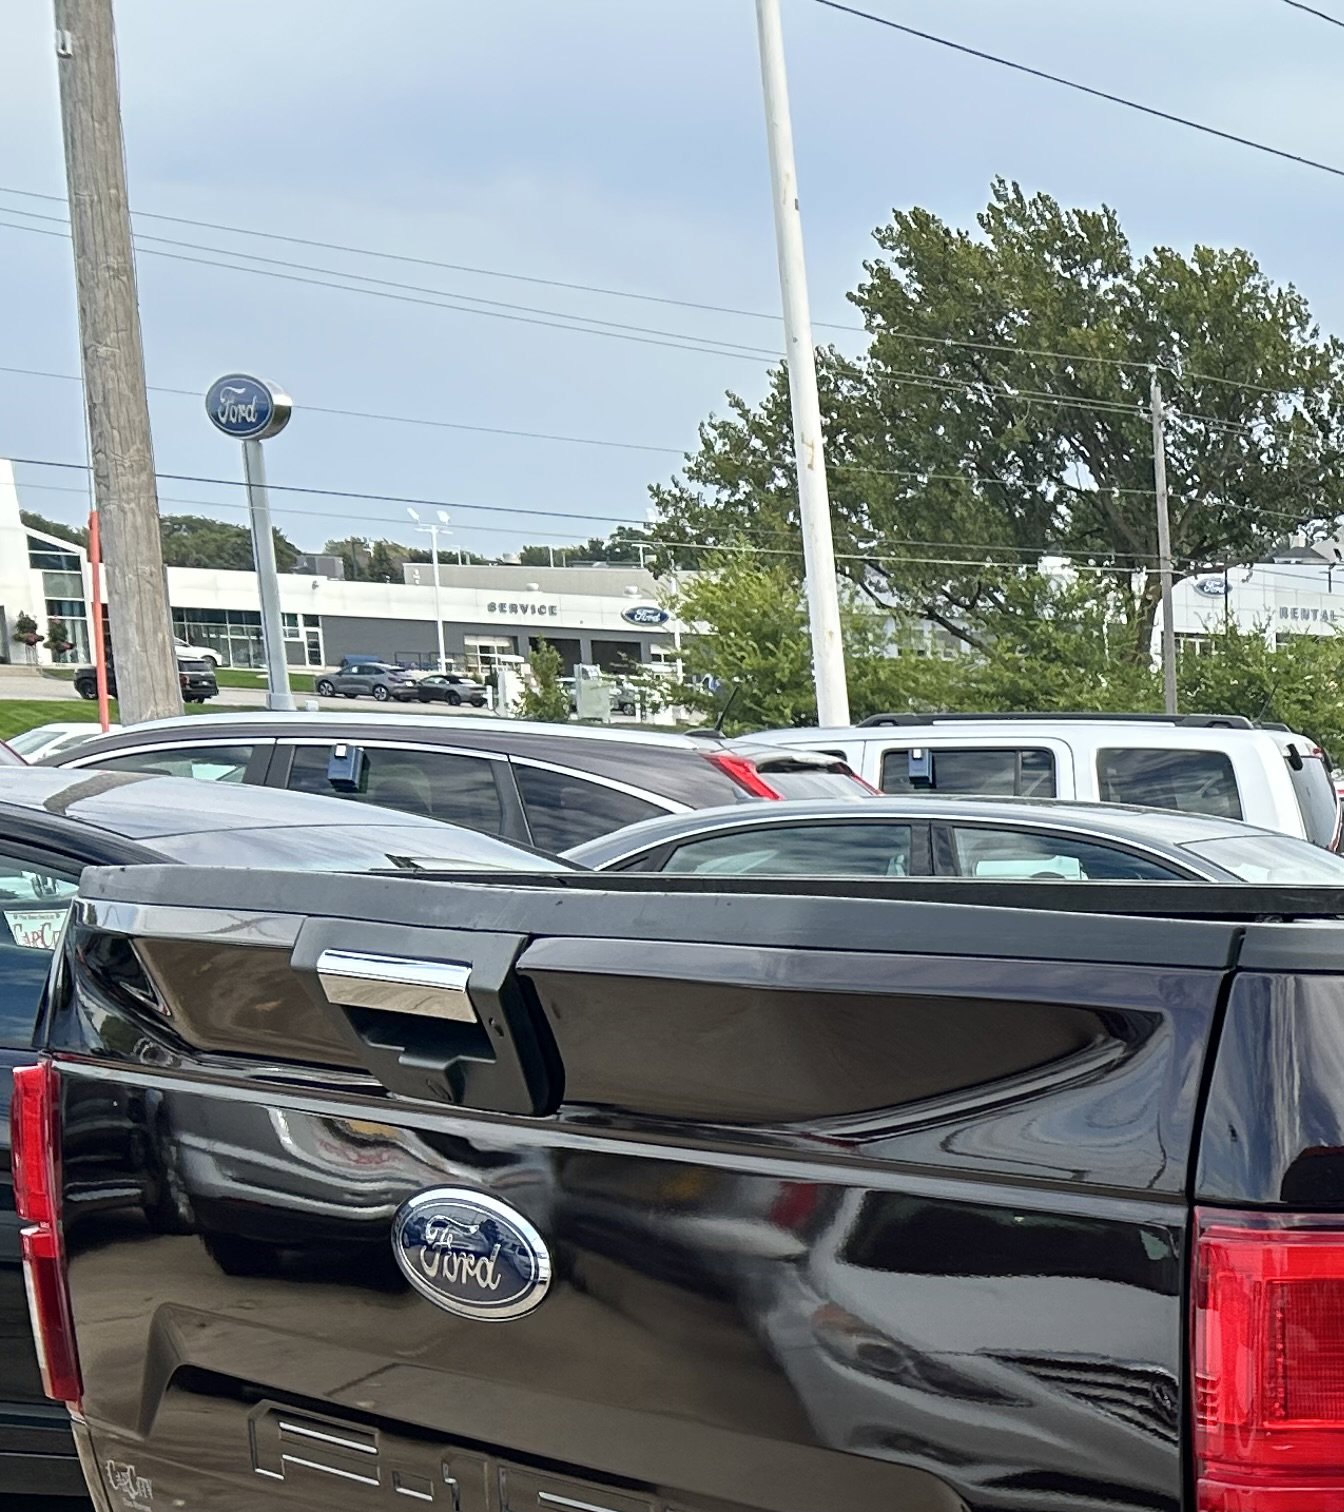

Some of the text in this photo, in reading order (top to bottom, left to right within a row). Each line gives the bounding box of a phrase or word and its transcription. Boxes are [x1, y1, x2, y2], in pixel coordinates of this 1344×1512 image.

[218, 386, 258, 424] Ford
[487, 602, 558, 616] SERVICE
[634, 609, 661, 623] Ford
[1279, 607, 1338, 622] RENTAL
[420, 1215, 501, 1290] Ford
